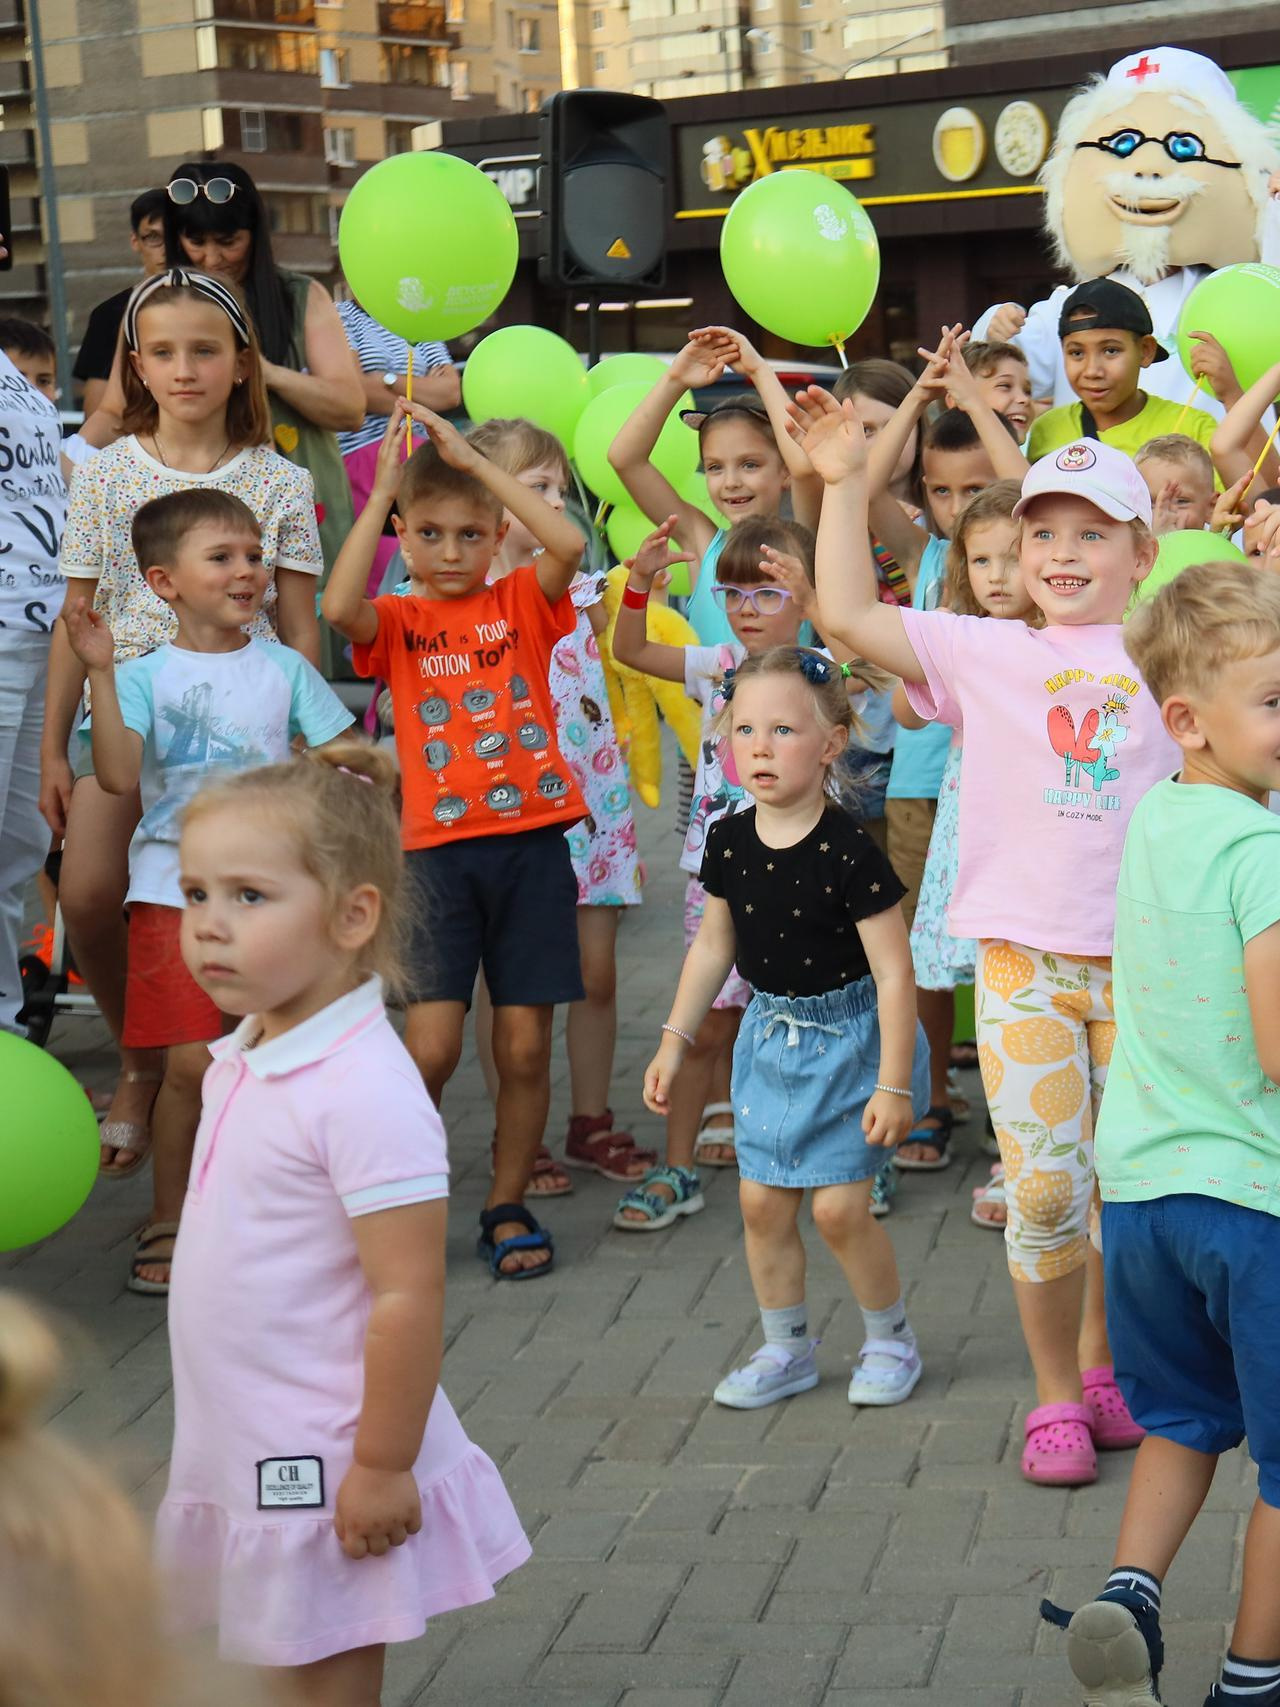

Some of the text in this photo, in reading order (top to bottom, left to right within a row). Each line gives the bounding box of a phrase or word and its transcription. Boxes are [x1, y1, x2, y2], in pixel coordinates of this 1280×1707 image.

[402, 629, 449, 653] WHAT
[1044, 668, 1141, 697] HAPPY MIND
[1043, 788, 1091, 809] HAPPY
[1066, 811, 1085, 820] COZY
[1085, 814, 1104, 823] MODE
[279, 1465, 300, 1482] CH
